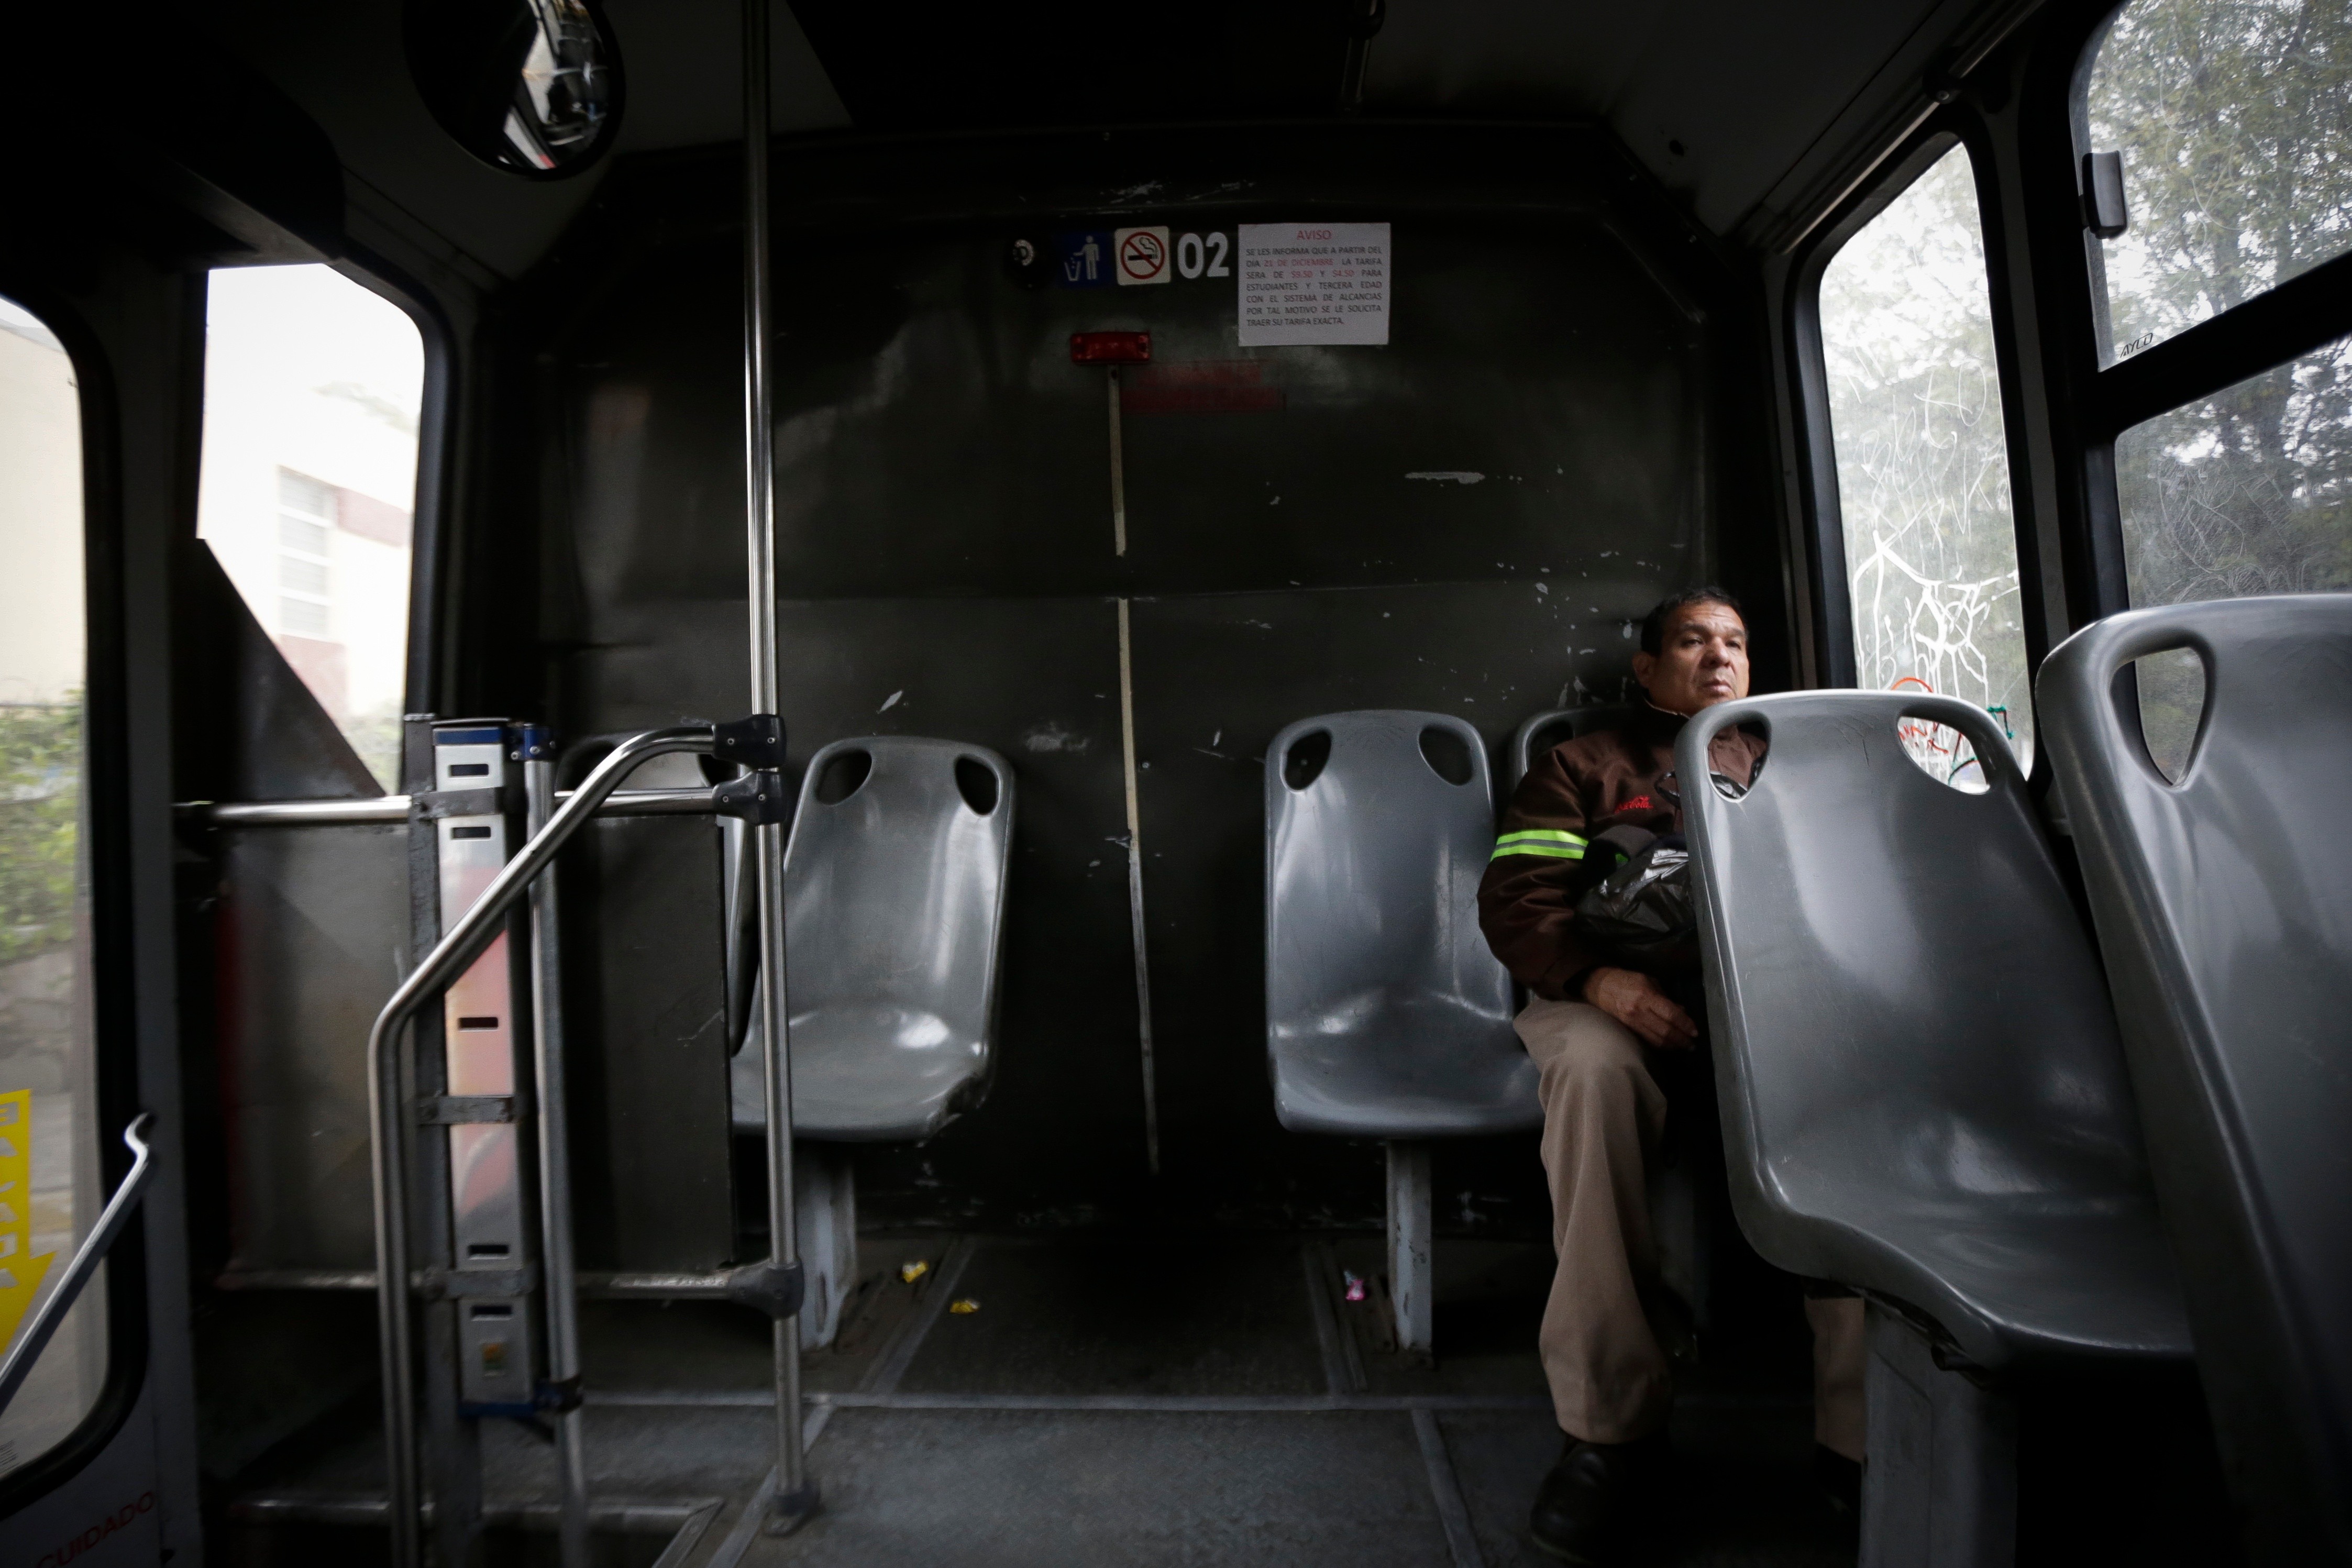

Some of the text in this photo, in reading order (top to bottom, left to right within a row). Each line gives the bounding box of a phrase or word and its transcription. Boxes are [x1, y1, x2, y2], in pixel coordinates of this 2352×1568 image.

[1296, 230, 1332, 240] AVISO
[1177, 231, 1230, 279] 02
[1246, 282, 1298, 291] ESTUDIANTES
[1284, 294, 1317, 302] SISTEMA
[1340, 293, 1382, 301] ALCANCIAS
[1246, 306, 1263, 315] POR
[1266, 306, 1280, 314] TAL
[1285, 305, 1318, 314] MOTIVO
[1321, 305, 1331, 313] SE
[1348, 304, 1382, 313] SOLICITA
[1247, 318, 1271, 327] TRAER
[36, 1491, 156, 1568] CUIDADO
